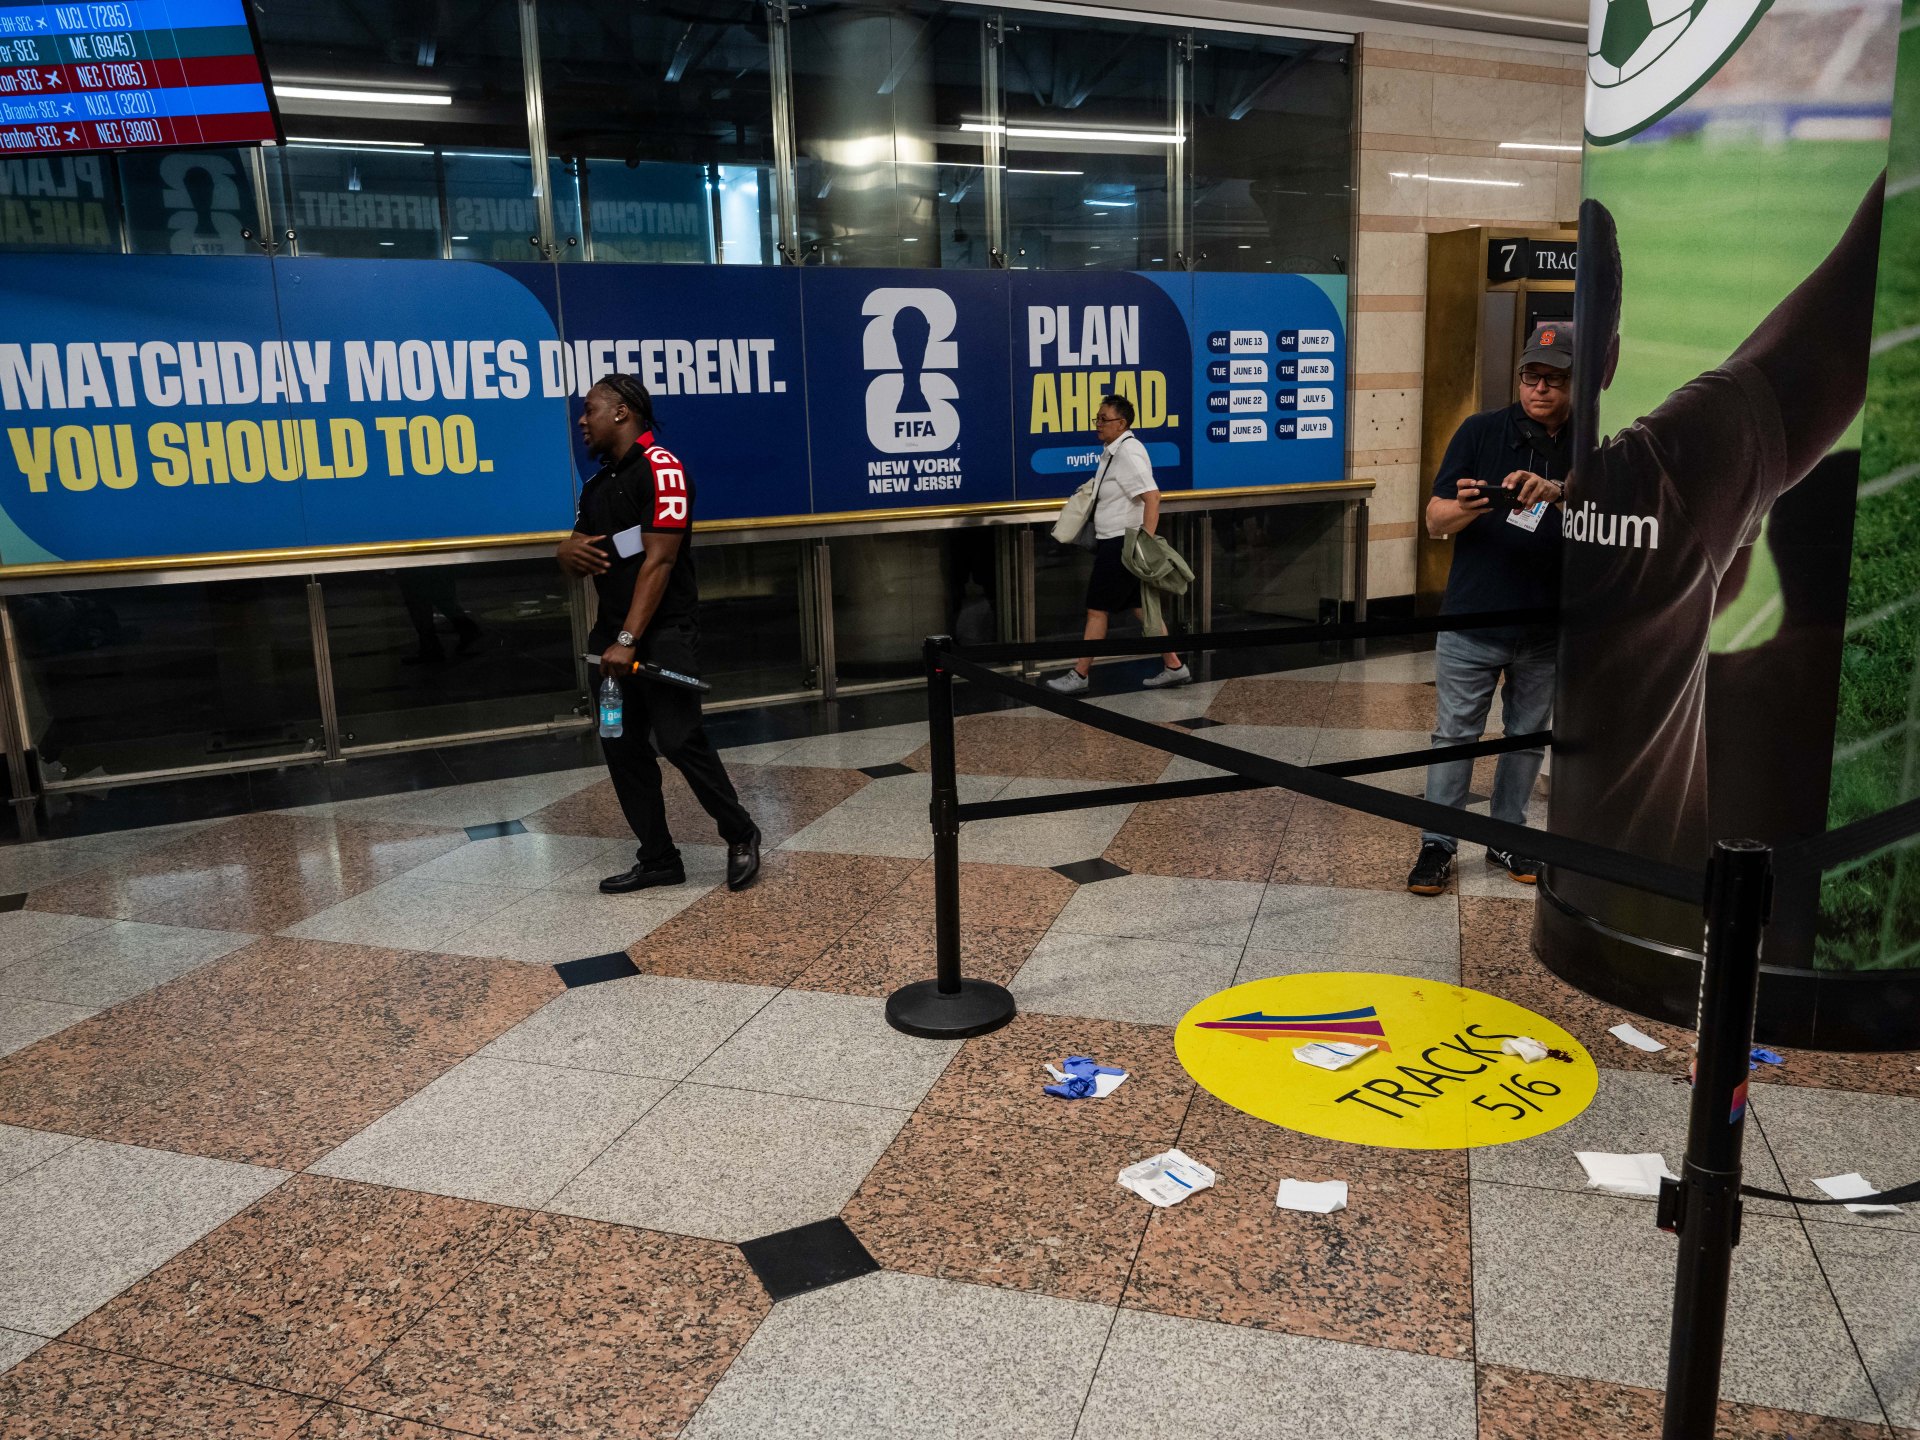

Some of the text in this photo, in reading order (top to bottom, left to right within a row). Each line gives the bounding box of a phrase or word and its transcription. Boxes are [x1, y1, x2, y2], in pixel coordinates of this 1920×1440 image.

[55, 4, 132, 30] NJCL (7285)
[69, 34, 136, 59] ME (6945)
[76, 62, 148, 88] NEC (7885)
[2, 100, 59, 121] Branch-SEC
[84, 91, 157, 116] NJCL (3201)
[95, 118, 163, 145] NEC (3801)
[1501, 245, 1517, 273] 7
[1028, 305, 1139, 367] PLAN
[1212, 337, 1263, 347] SAT JUNE 13
[1281, 336, 1329, 345] SAT JUNE 27
[0, 338, 787, 411] MATCHDAY MOVES DIFFERENT.
[1212, 366, 1262, 376] TUE JUNE 16
[1281, 365, 1329, 375] TUE JUNE 30
[1210, 396, 1262, 406] MON JUNE 22
[1280, 394, 1326, 404] SUN JULY 5
[894, 421, 937, 438] FIFA
[1211, 426, 1262, 436] THU JUNE 25
[1279, 423, 1327, 433] SUN JULY 19
[7, 414, 494, 493] YOU SHOULD TOO.
[868, 457, 962, 476] NEW YORK
[868, 475, 963, 494] NEW JERSEY
[1471, 1073, 1562, 1120] 5/6
